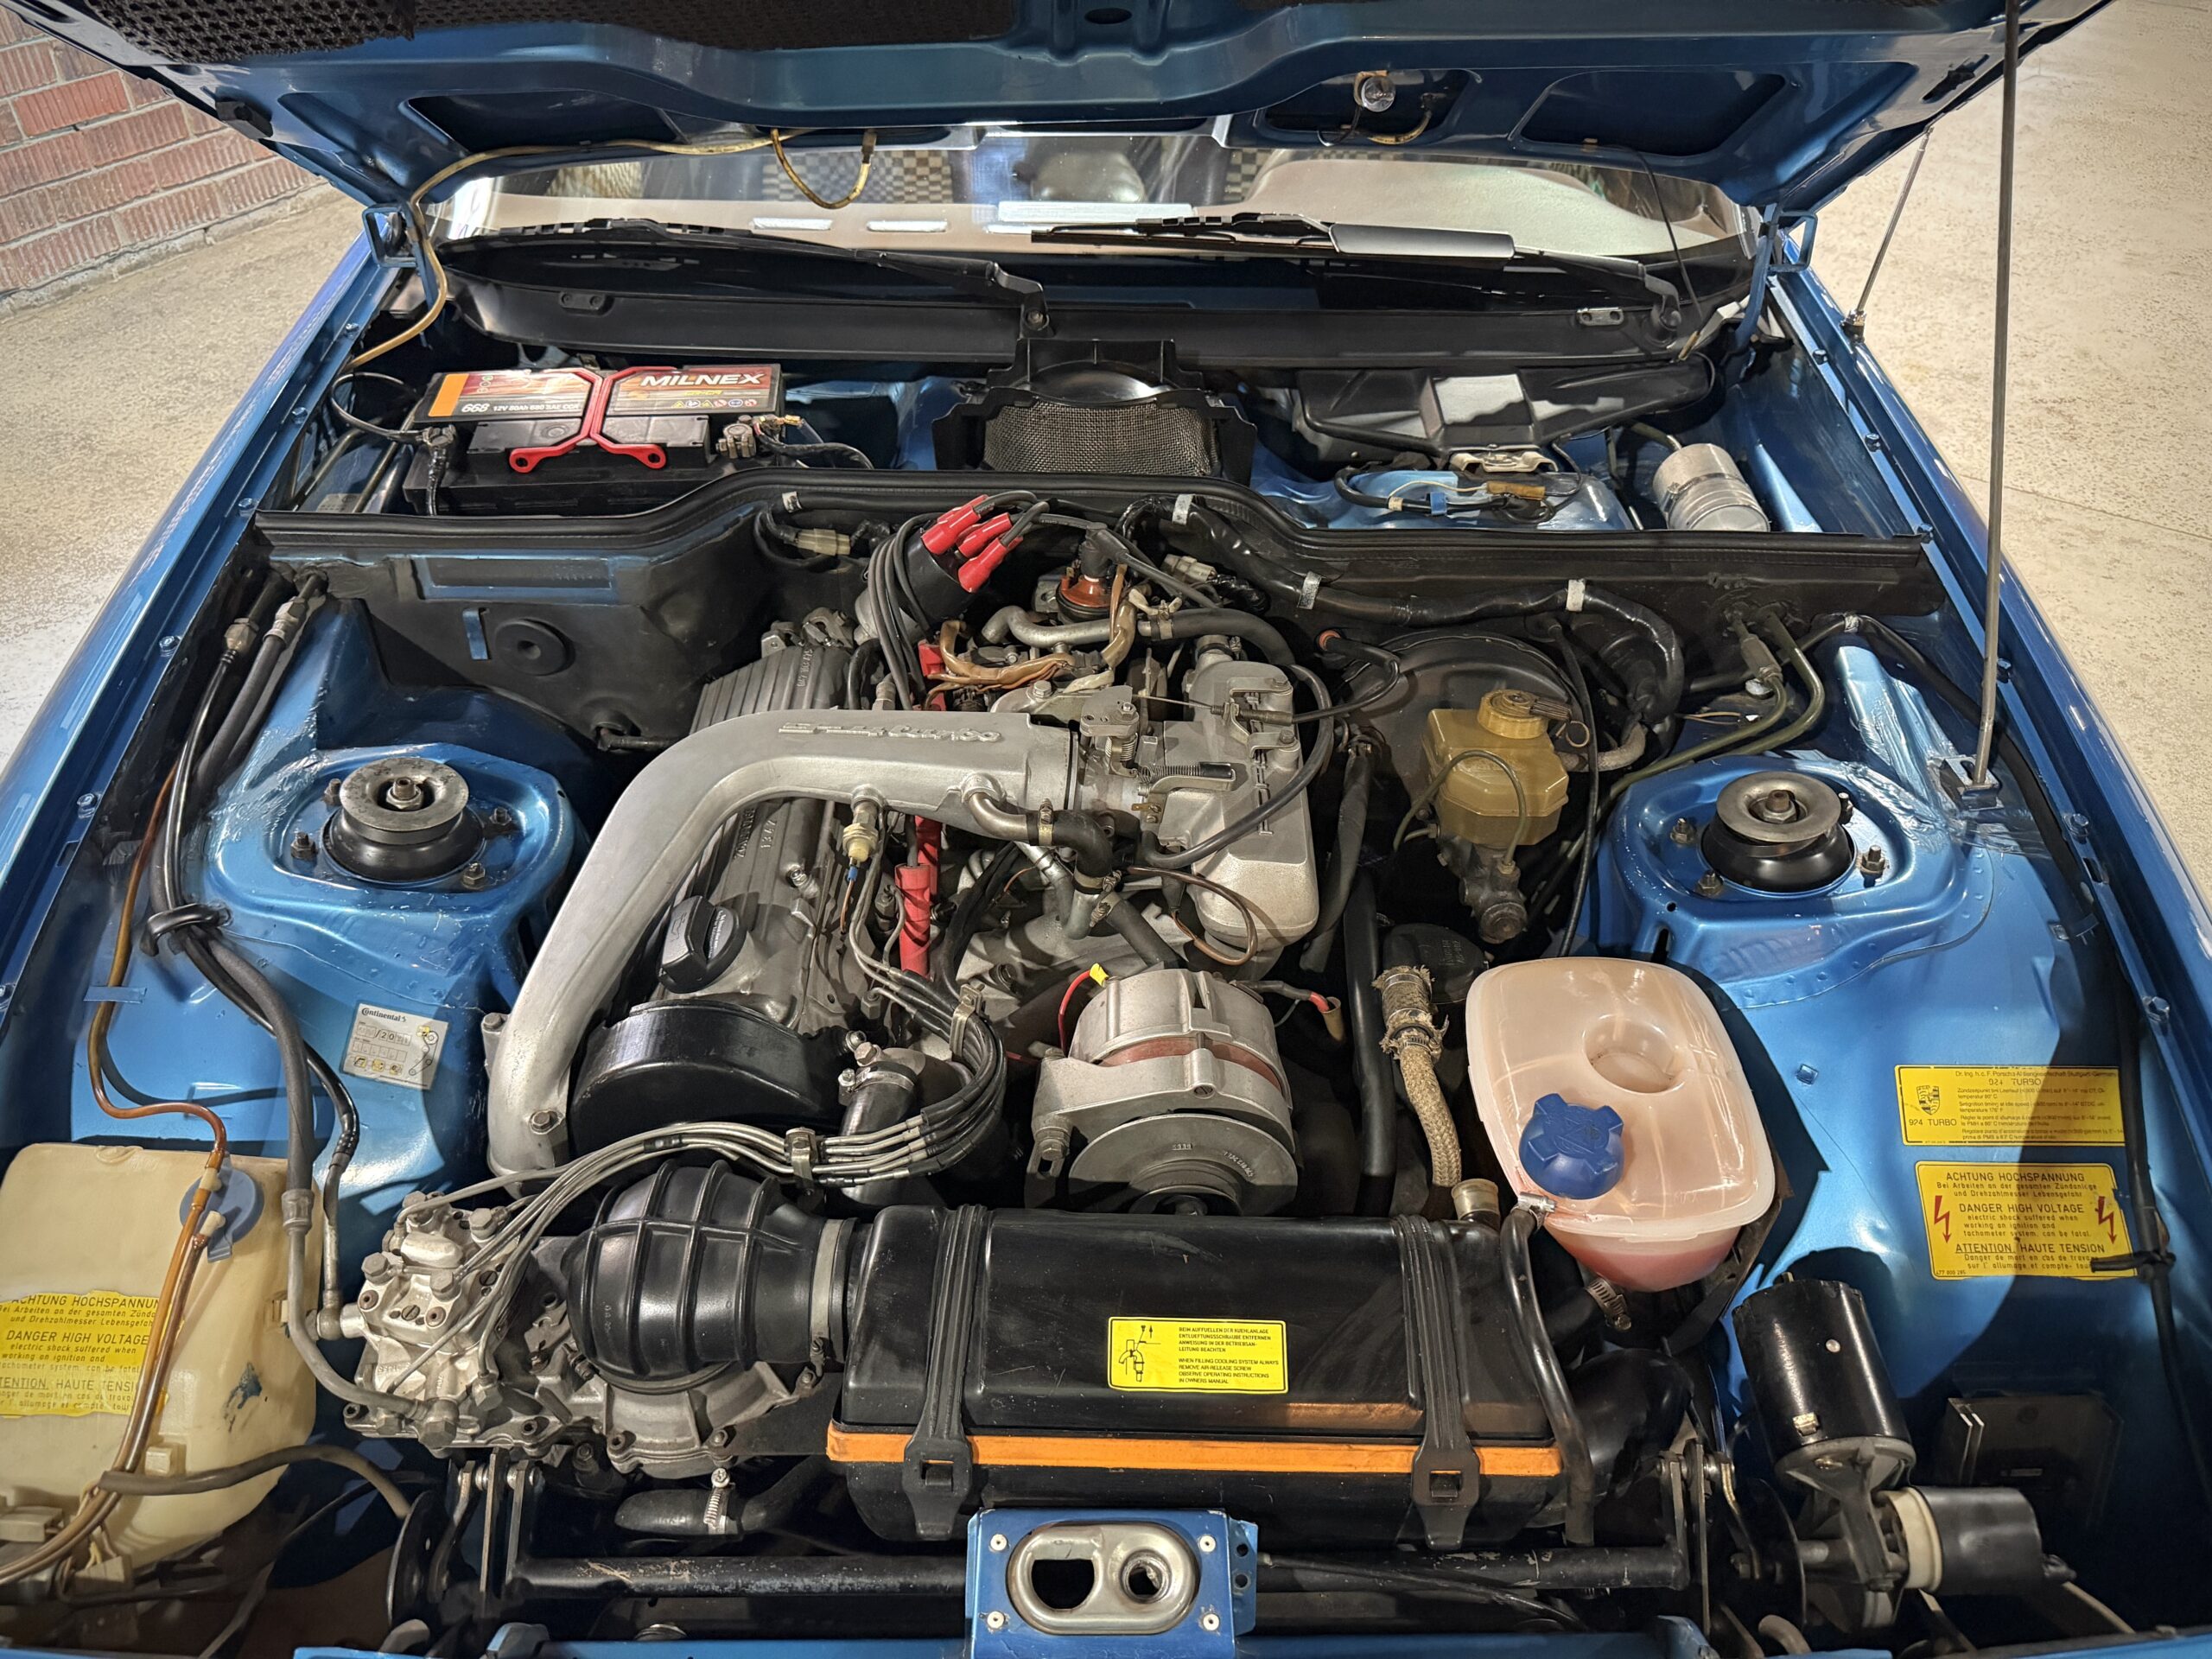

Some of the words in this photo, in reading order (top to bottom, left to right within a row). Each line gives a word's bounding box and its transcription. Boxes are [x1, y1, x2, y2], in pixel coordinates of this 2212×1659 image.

[639, 373, 765, 386] MILNEX
[461, 403, 491, 413] 668
[361, 1007, 401, 1022] Continental
[1946, 1172, 1994, 1181] ACHTUNG
[1999, 1172, 2085, 1182] HOCHSPANNUNG
[1959, 1203, 2003, 1212] DANGER
[2007, 1204, 2033, 1213] HIGH
[2036, 1204, 2085, 1213] VOLTAGE
[2020, 1243, 2056, 1253] HAUTE
[2059, 1243, 2106, 1253] TENSION
[72, 1296, 160, 1309] HOCHSPANNUN
[14, 1306, 50, 1314] Arbeiten
[86, 1309, 126, 1318] gesamten
[29, 1315, 97, 1325] Drehzahlmesser
[100, 1318, 153, 1327] Lebensgefah
[6, 1329, 58, 1342] DANGER
[61, 1332, 92, 1343] HIGH
[96, 1333, 150, 1345] VOLTAGE
[74, 1344, 111, 1354] suffered
[2, 1352, 35, 1362] working
[54, 1354, 86, 1363] ignition
[55, 1379, 95, 1390] HAUTE
[103, 1380, 134, 1392] TENSI
